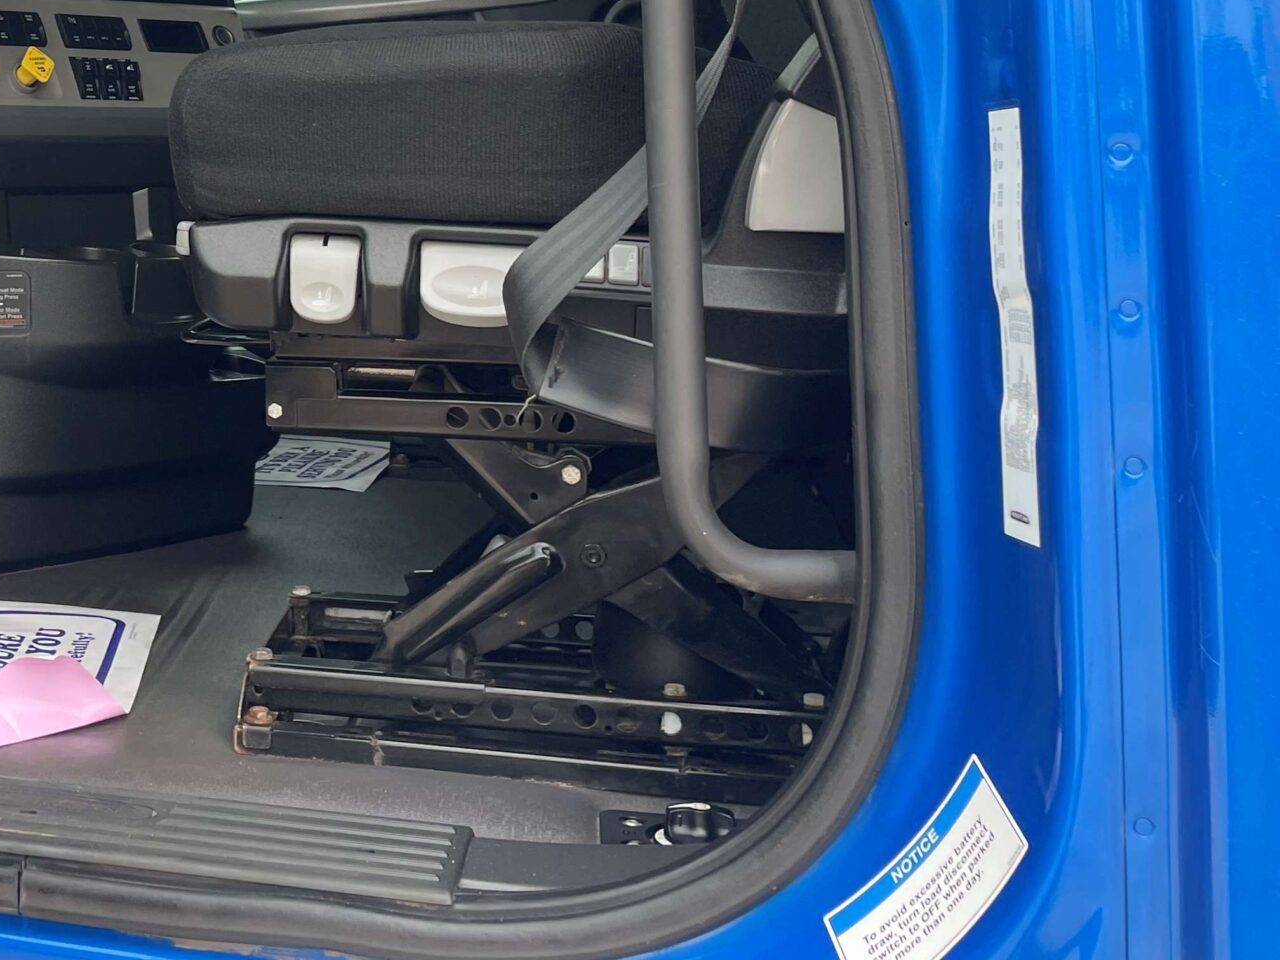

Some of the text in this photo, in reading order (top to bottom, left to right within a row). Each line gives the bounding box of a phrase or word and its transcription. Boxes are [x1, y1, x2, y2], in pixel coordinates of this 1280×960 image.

[25, 627, 67, 656] YOU
[67, 632, 96, 662] efully!
[862, 815, 984, 944] To avoid excessive battery
[890, 827, 940, 885] NOTICE
[898, 908, 920, 931] turn
[920, 883, 943, 910] load
[942, 823, 989, 887] disconnect
[908, 922, 920, 936] to
[920, 899, 942, 923] OFF
[943, 871, 968, 901] when
[967, 830, 996, 874] parked
[894, 868, 985, 960] more than one day.
